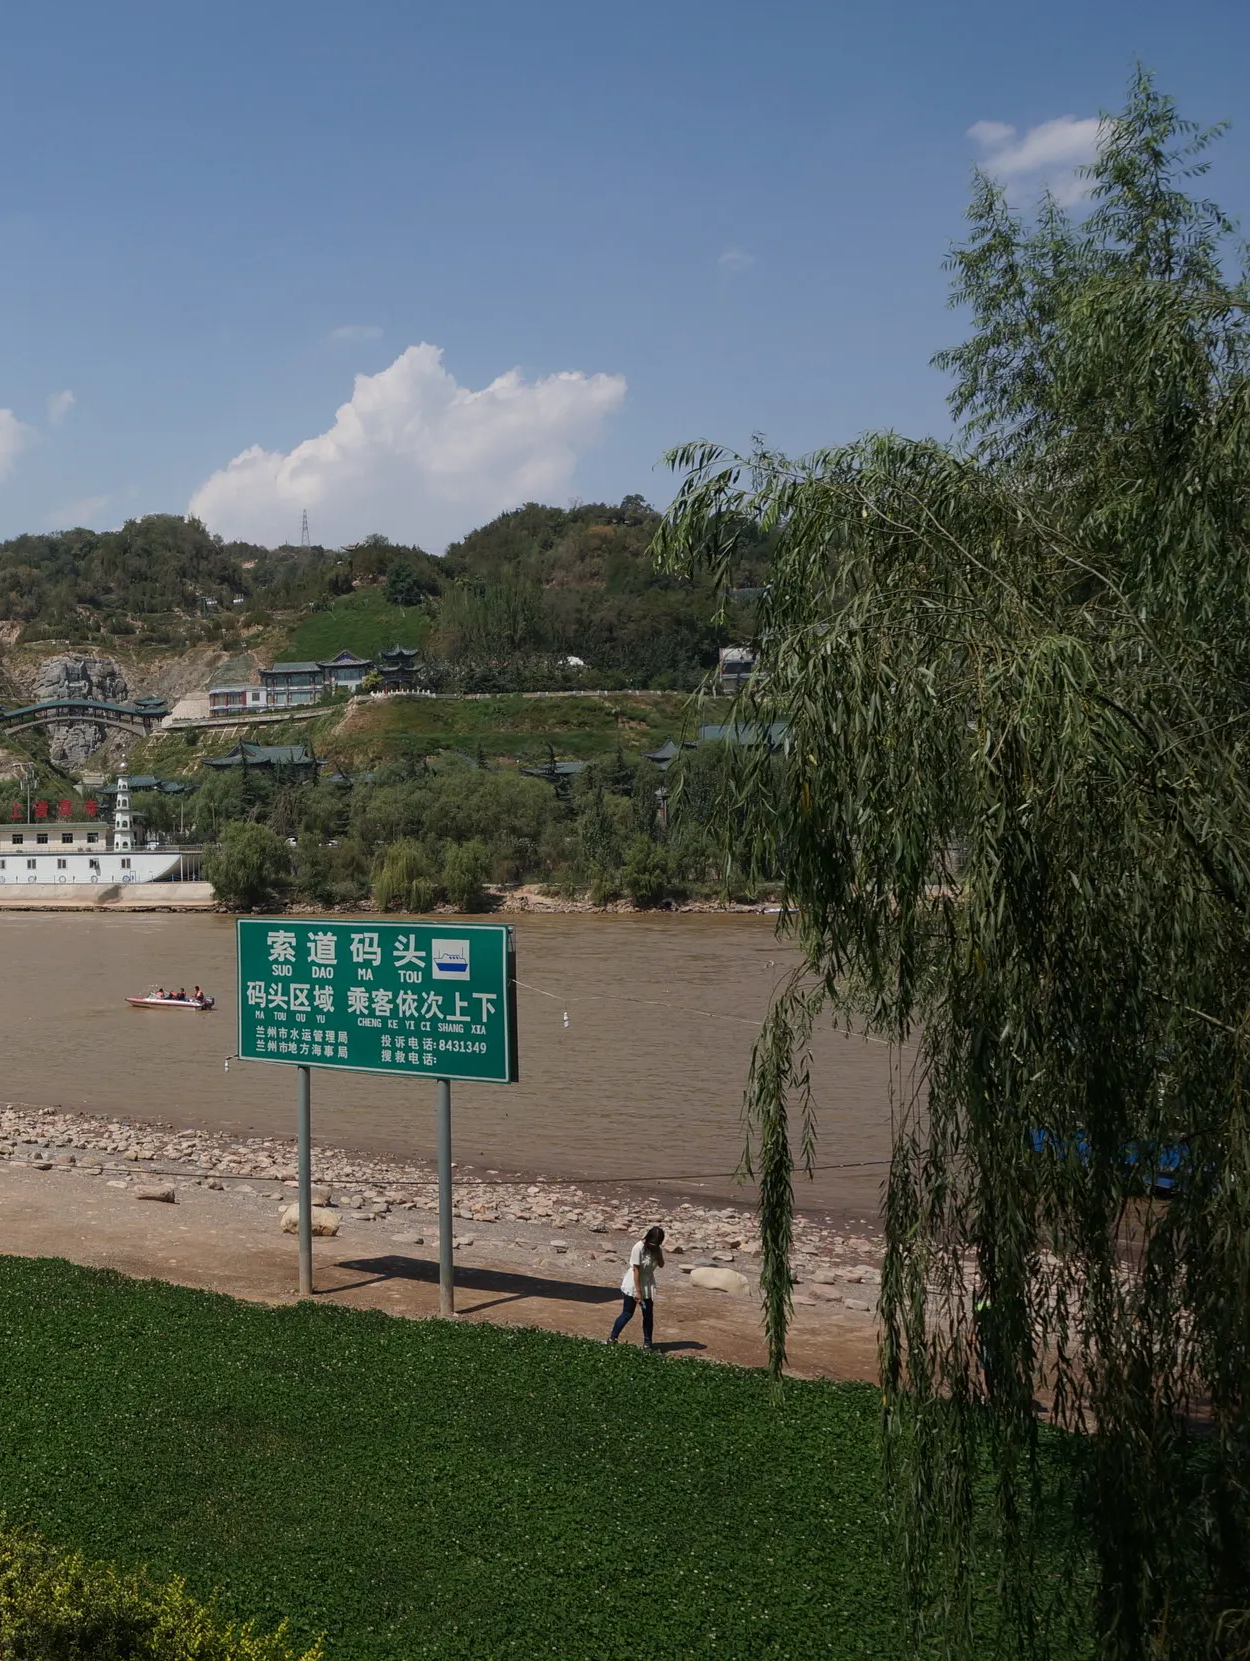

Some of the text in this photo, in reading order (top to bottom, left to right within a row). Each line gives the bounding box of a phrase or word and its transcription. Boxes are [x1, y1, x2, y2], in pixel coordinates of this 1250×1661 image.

[266, 930, 426, 968] 索道码头
[271, 964, 422, 984] SUO DAO MA TOU
[246, 981, 335, 1012] 码头区域
[346, 986, 498, 1023] 乘客依次上下
[254, 1010, 326, 1024] MA TOU QU YU
[357, 1017, 486, 1035] CHENG KE YI CI SHANG XIA
[255, 1025, 348, 1044] 兰州市水运管理局
[255, 1040, 348, 1059] 兰州市地方海事局
